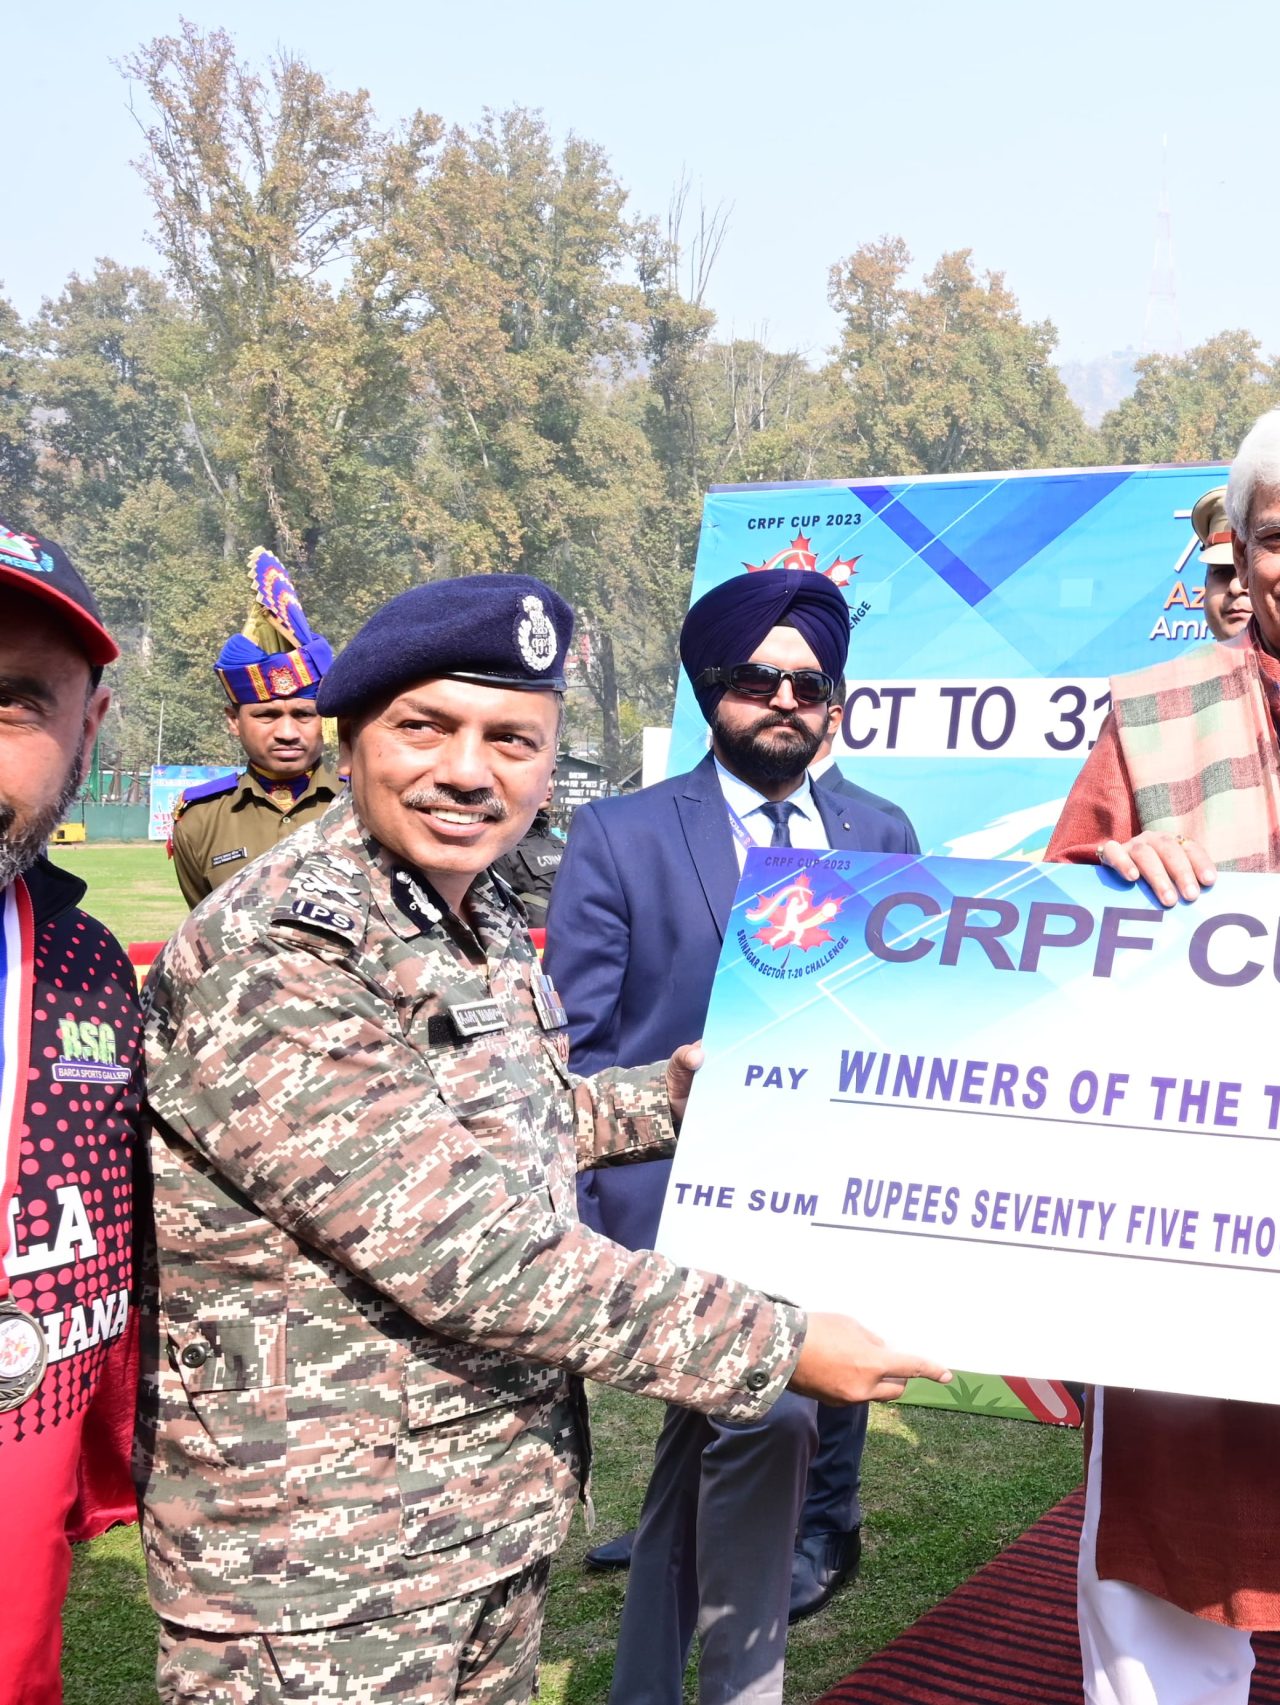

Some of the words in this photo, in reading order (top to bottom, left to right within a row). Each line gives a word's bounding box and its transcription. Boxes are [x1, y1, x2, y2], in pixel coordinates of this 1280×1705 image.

[747, 517, 785, 530] CRPF
[791, 515, 820, 528] CUP
[826, 513, 862, 527] 2023
[849, 600, 872, 630] ENGE
[841, 686, 916, 750] CT
[940, 685, 1016, 751] TO
[764, 855, 794, 867] CRPF
[797, 858, 820, 869] CUP
[823, 859, 851, 871] 2023
[295, 900, 350, 929] IPS
[863, 891, 1164, 979] CRPF
[736, 929, 760, 969] SRINAGAR
[758, 963, 785, 980] SECTOR
[787, 967, 803, 979] T-20
[805, 935, 849, 975] CHALLENGE
[58, 1067, 80, 1077] BARCA
[80, 1069, 102, 1079] SPORTS
[744, 1064, 809, 1090] PAY
[838, 1050, 1048, 1110] WINNERS
[1069, 1070, 1130, 1117] OF
[1150, 1077, 1241, 1127] THE
[3, 1185, 98, 1277] LA
[674, 1182, 735, 1208] THE
[748, 1189, 818, 1216] SUM
[841, 1176, 960, 1225] RUPEES
[971, 1190, 1116, 1241] SEVENTY
[1125, 1205, 1198, 1250] FIVE
[37, 1289, 129, 1363] HANA
